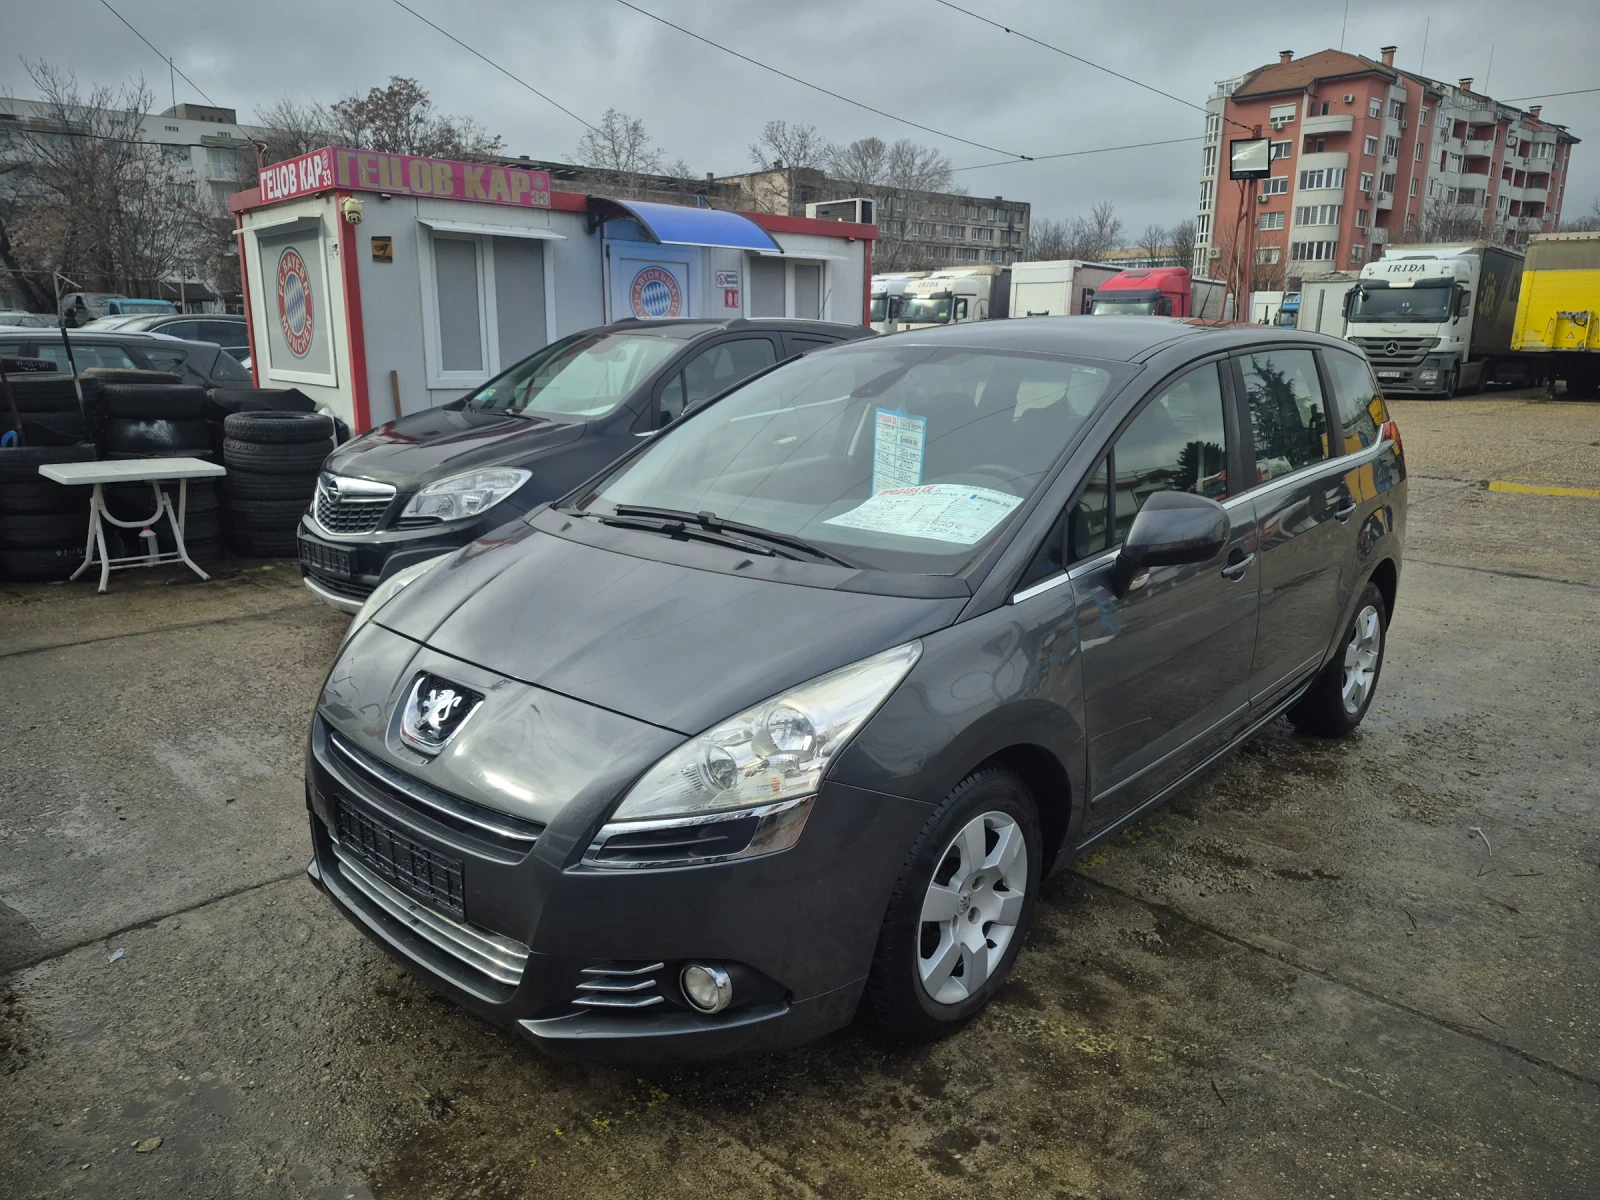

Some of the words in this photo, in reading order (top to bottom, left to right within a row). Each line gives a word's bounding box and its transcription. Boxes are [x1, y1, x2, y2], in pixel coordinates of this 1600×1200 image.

[260, 163, 297, 201] ГЕЦОВ
[299, 155, 322, 191] КАР
[322, 169, 332, 186] 33
[336, 150, 454, 196] ГЕЦОВ
[463, 165, 530, 203] КАР
[530, 190, 549, 206] 33
[282, 254, 310, 297] BAYERN
[1386, 264, 1426, 272] IRIDA
